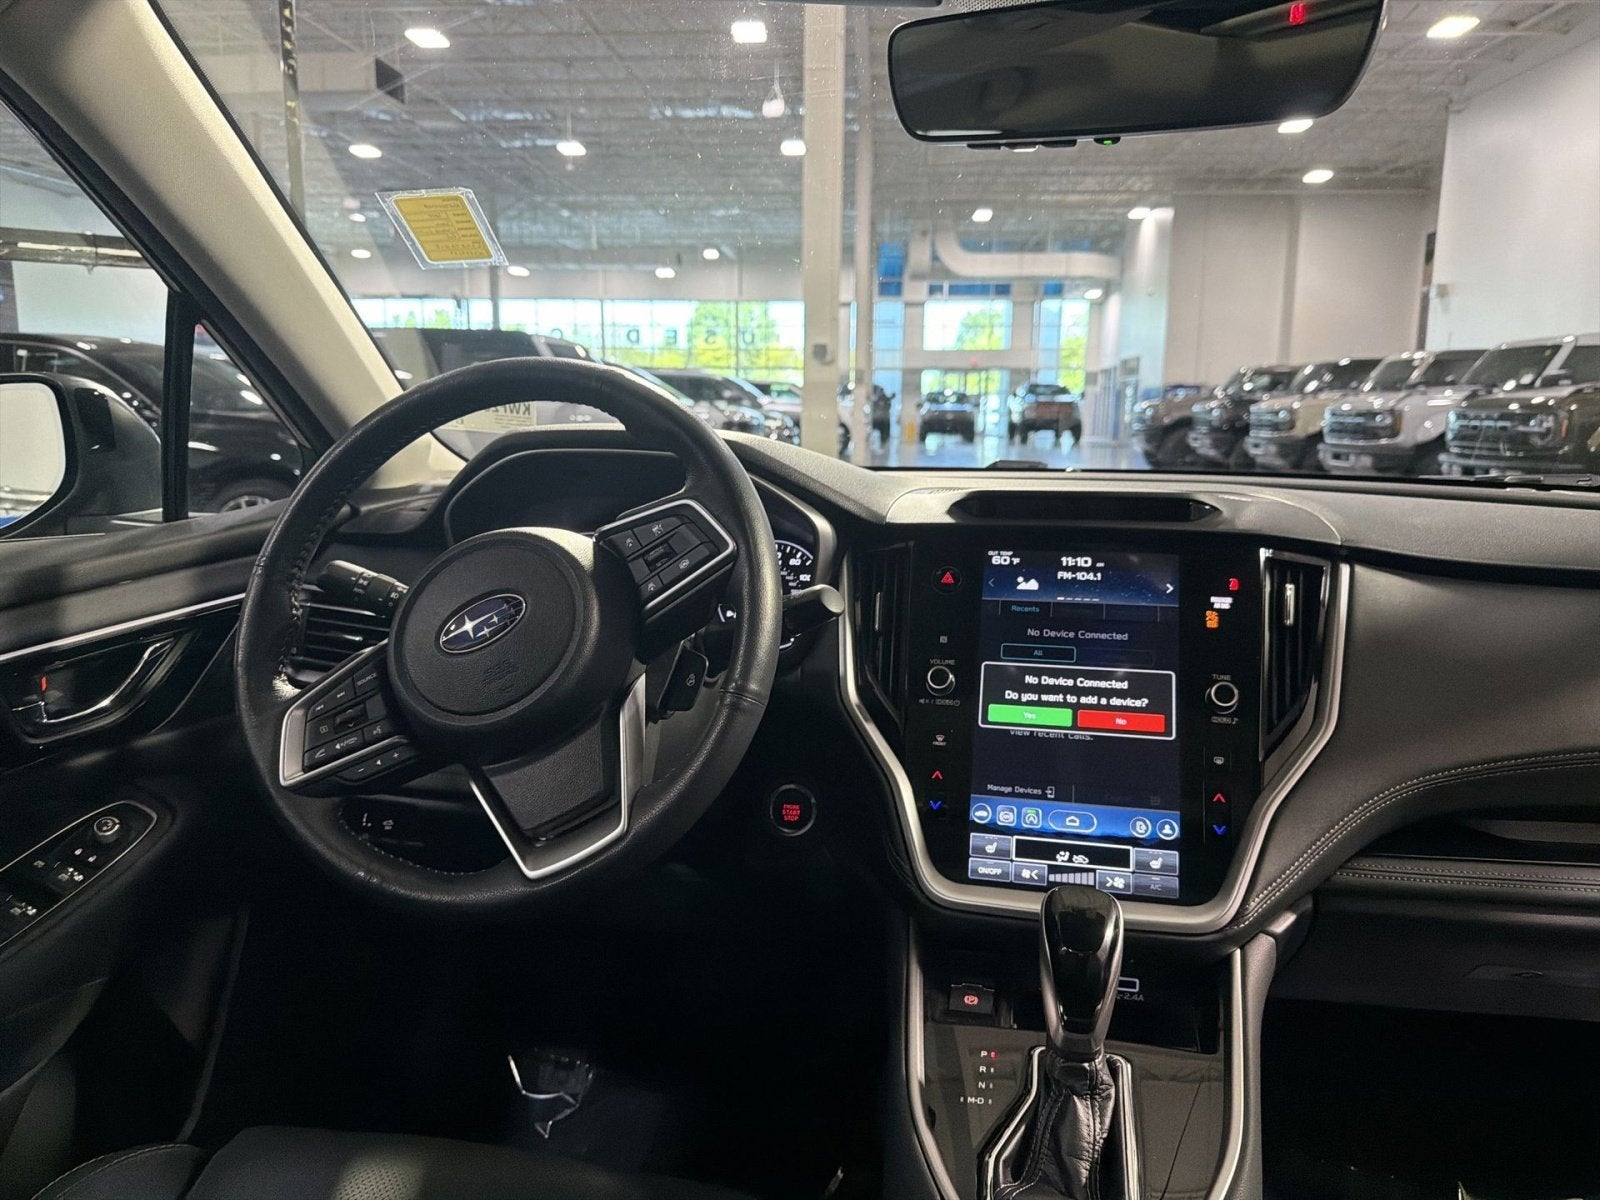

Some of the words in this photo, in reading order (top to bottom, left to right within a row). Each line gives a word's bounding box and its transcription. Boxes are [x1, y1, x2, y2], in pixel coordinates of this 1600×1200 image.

[1060, 556, 1092, 568] 11:10
[1057, 571, 1102, 581] FM-104.1
[1011, 605, 1040, 613] Recents
[1027, 628, 1041, 637] No
[1043, 629, 1075, 638] Device
[1078, 630, 1129, 641] Connected
[1024, 675, 1038, 685] No
[1041, 676, 1074, 686] Device
[1076, 678, 1129, 689] Connected
[1211, 673, 1232, 681] TUNE
[1004, 690, 1019, 700] Do
[1021, 693, 1038, 703] you
[1041, 693, 1064, 702] want
[1066, 694, 1077, 703] to
[1080, 694, 1098, 704] add
[1100, 697, 1107, 705] a
[1109, 696, 1149, 707] device?
[1023, 711, 1036, 720] Yes
[1115, 717, 1127, 726] No
[987, 784, 1013, 794] Manage
[1014, 786, 1042, 795] Devices
[977, 866, 1002, 876] ON/OFF
[980, 1050, 988, 1058] P
[979, 1065, 987, 1073] R
[978, 1081, 986, 1089] N
